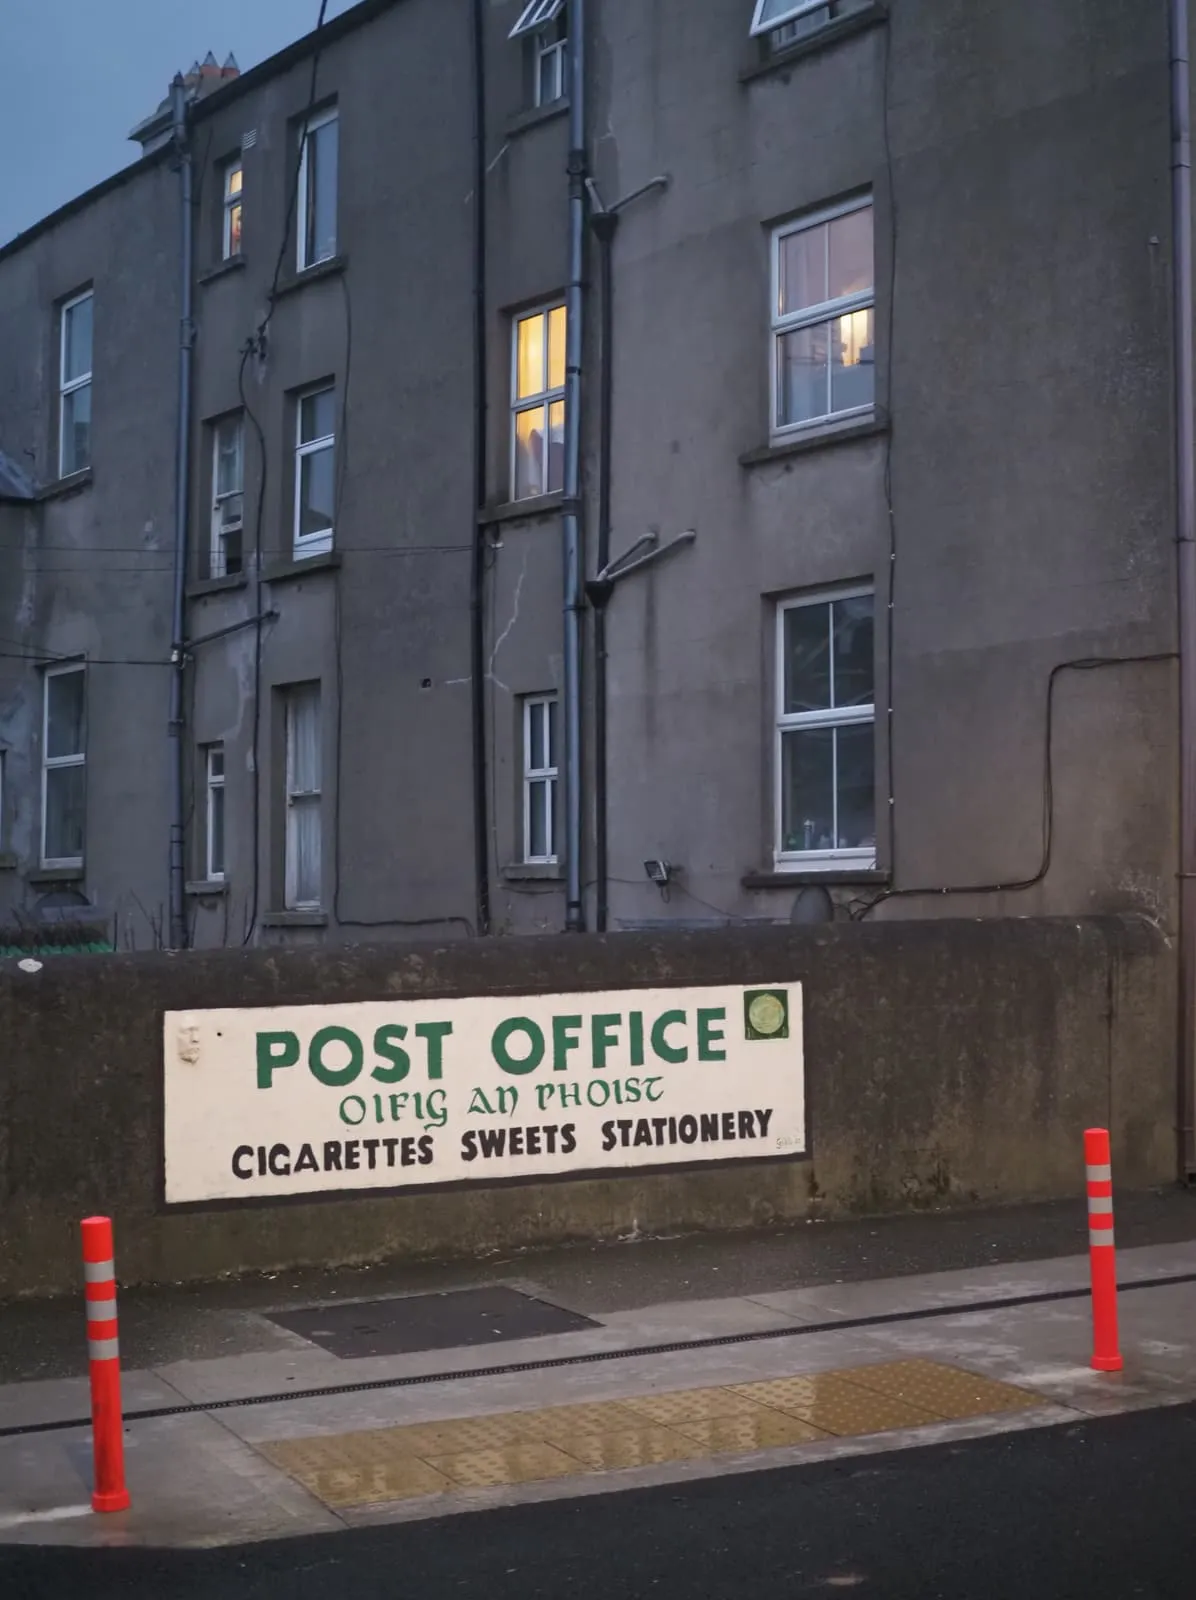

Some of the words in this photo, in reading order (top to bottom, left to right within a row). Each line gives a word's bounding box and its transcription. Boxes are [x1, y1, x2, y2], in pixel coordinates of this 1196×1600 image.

[256, 1022, 452, 1088] POST
[491, 1008, 725, 1075] OFFICE
[231, 1135, 434, 1180] CIGARETTES
[461, 1123, 577, 1161] SWEETS
[602, 1108, 773, 1151] STATIONERY
